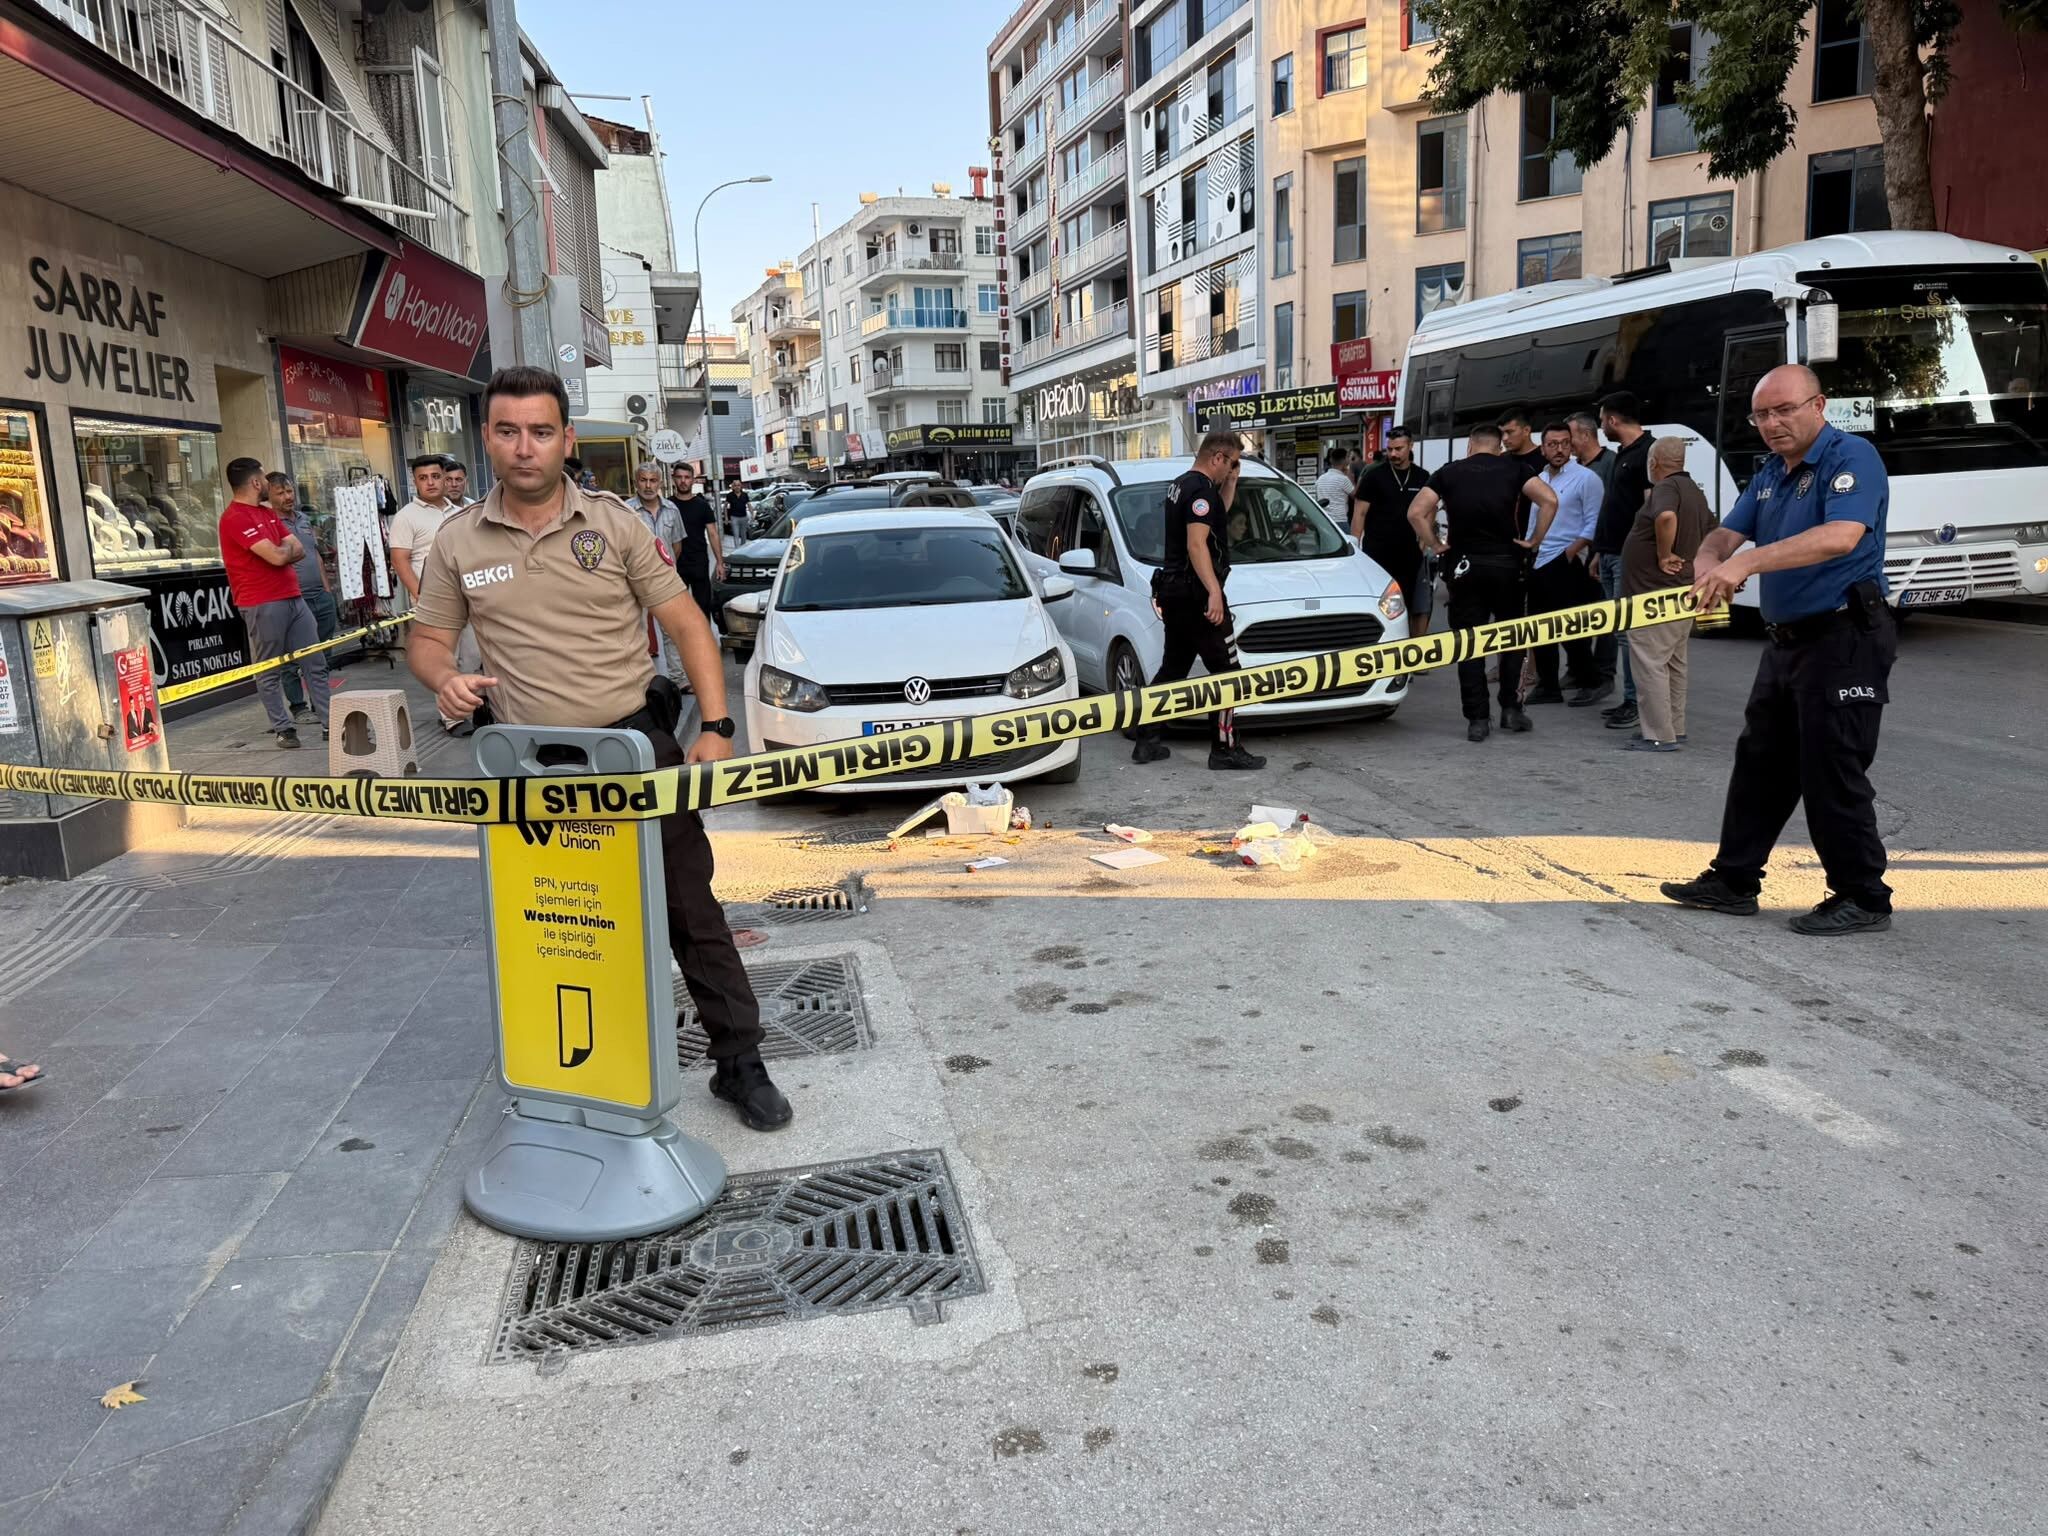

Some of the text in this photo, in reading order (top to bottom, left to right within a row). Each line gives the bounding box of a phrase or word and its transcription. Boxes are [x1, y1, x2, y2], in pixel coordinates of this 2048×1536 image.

[29, 256, 167, 338] SARRAF
[400, 285, 478, 347] Hayal Moda
[24, 326, 195, 403] JUWELIER
[1346, 375, 1379, 386] ADIYAMAN
[1039, 377, 1086, 421] DeFacto
[1206, 402, 1256, 419] GÜNEŞ
[1261, 387, 1336, 415] İLETİŞİM
[1340, 385, 1386, 401] OSMANLI
[1852, 400, 1873, 418] S-4
[462, 564, 514, 590] BEKÇİ
[1643, 588, 1699, 620] OLİS
[1905, 589, 1963, 603] 07 CHF 944
[160, 586, 235, 629] KOÇAK
[188, 634, 224, 652] PIRLANTA
[171, 659, 202, 679] SATIŞ
[203, 650, 243, 673] NOKTASI
[559, 820, 616, 837] Western
[559, 833, 601, 851] Union
[534, 876, 599, 896] BPN, yurtdışı
[535, 893, 602, 913] işlemleri için
[523, 909, 616, 930] Western Union
[543, 928, 596, 947] ile işbirliği
[536, 943, 605, 962] içerisindedir.
